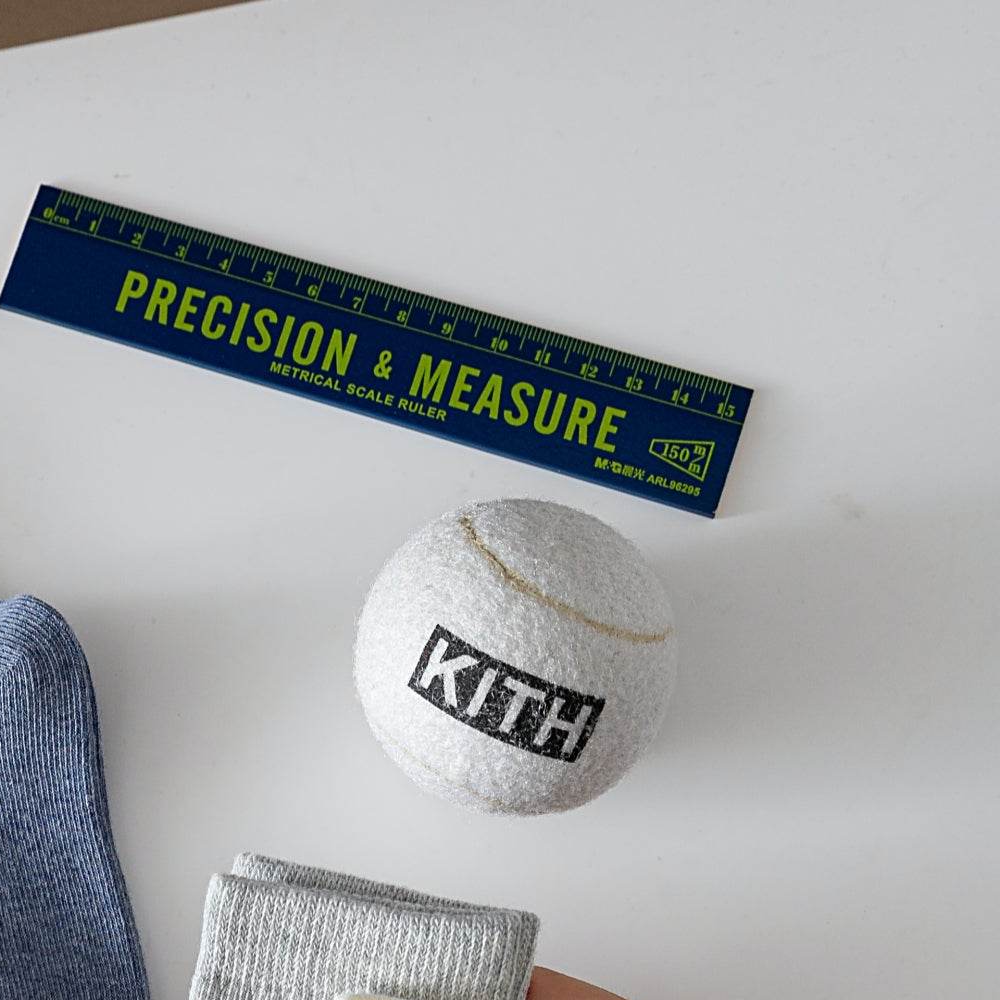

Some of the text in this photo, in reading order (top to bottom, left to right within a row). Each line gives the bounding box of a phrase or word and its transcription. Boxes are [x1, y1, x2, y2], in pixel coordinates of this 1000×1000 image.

[88, 219, 98, 232] 1
[130, 231, 143, 245] 2
[174, 244, 187, 258] 3
[217, 258, 229, 271] 4
[262, 270, 274, 284] 5
[307, 283, 319, 298] 6
[352, 296, 363, 310] 7
[396, 309, 408, 323] 8
[440, 322, 452, 336] 9
[489, 335, 509, 352] 10
[533, 349, 552, 365] 11
[579, 362, 599, 379] 12
[625, 375, 645, 391] 13
[671, 388, 690, 405] 14
[716, 401, 736, 418] 15
[115, 270, 628, 453] PRECISION & MEASURE
[269, 361, 447, 421] METRICAL SCALE RULER
[661, 443, 691, 463] 150
[417, 637, 593, 755] KITH
